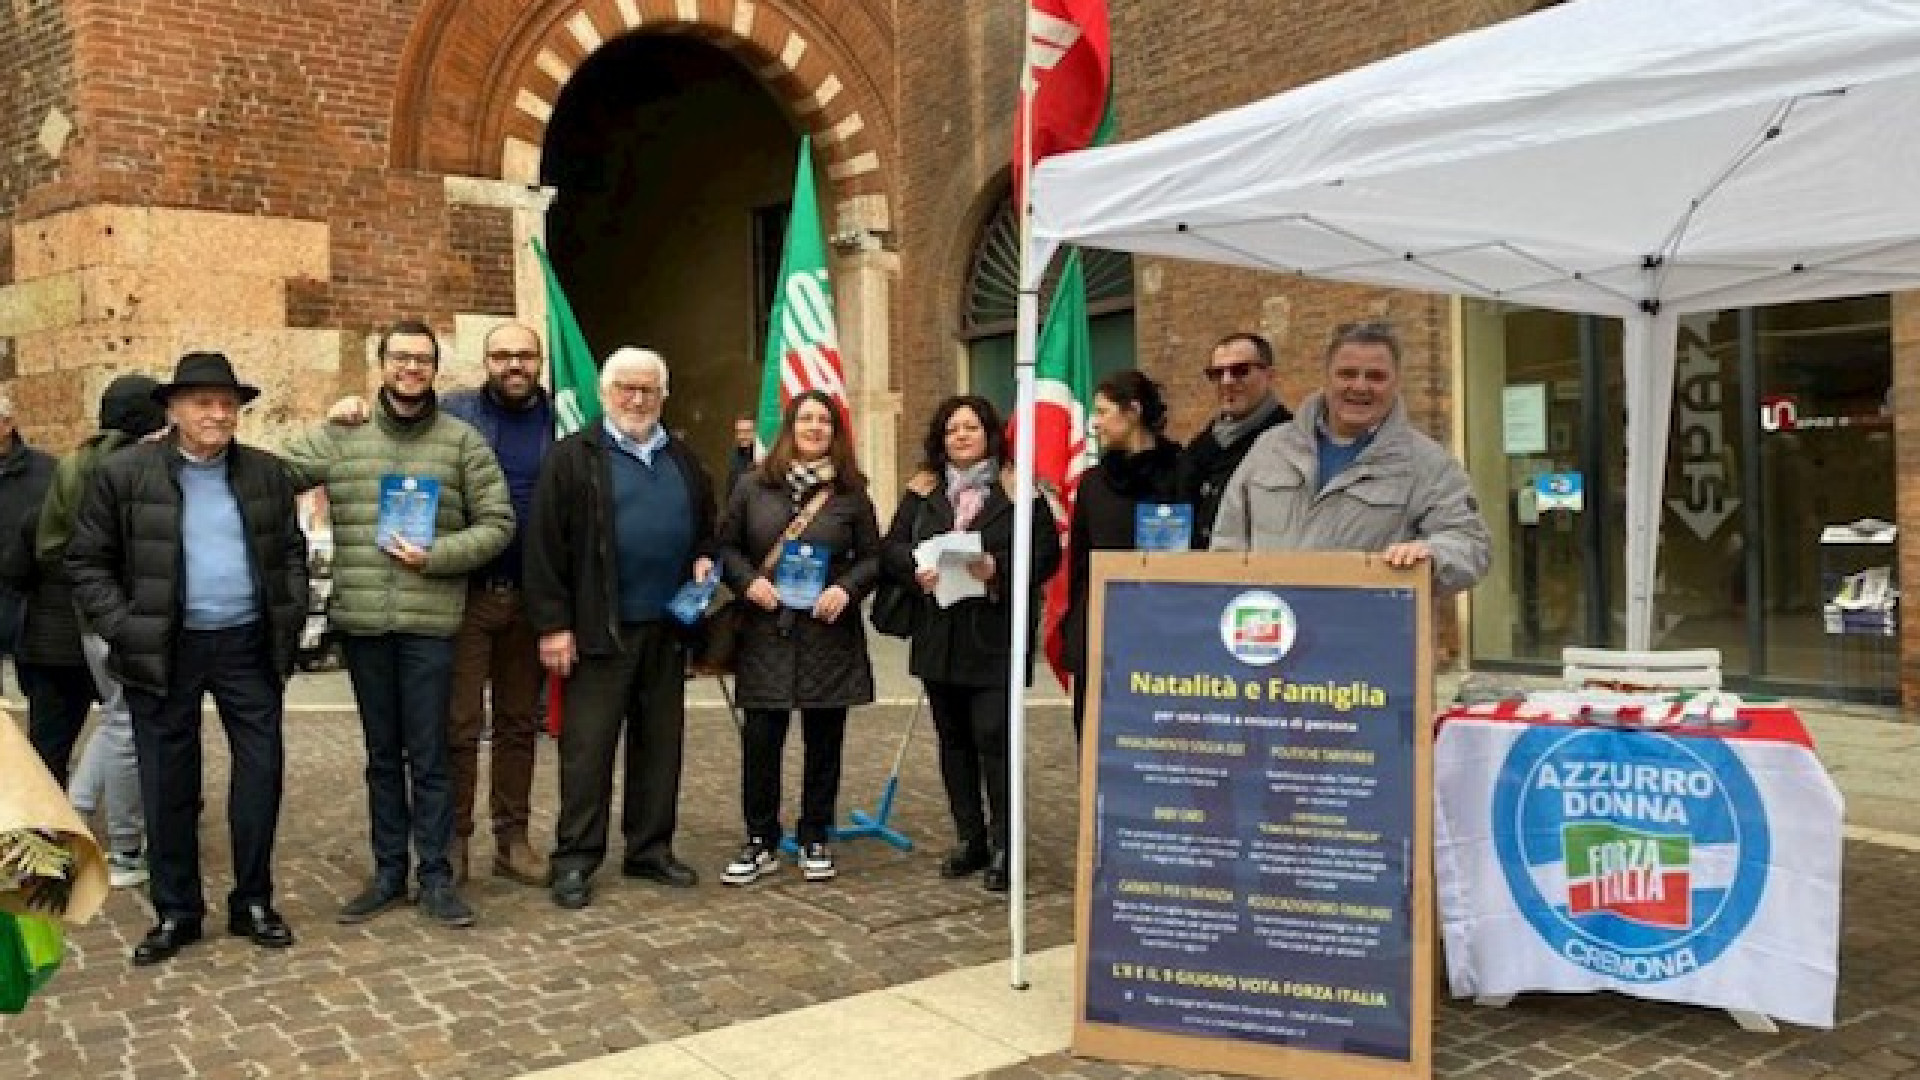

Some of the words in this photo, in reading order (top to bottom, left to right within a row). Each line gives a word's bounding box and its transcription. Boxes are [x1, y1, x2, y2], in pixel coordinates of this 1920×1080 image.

[1130, 671, 1237, 699] Natalità
[1244, 680, 1261, 700] e
[1268, 678, 1387, 711] Famiglia
[1536, 761, 1714, 798] AZZURRO
[1563, 790, 1690, 826] DONNA
[1588, 837, 1661, 877] FORZA
[1590, 862, 1666, 910] ITALIA
[1564, 937, 1698, 980] CREMONA
[1175, 969, 1237, 990] GIUGNO
[1238, 975, 1281, 995] VOTA
[1283, 980, 1333, 1001] FORZA
[1336, 987, 1389, 1007] ITALIA
